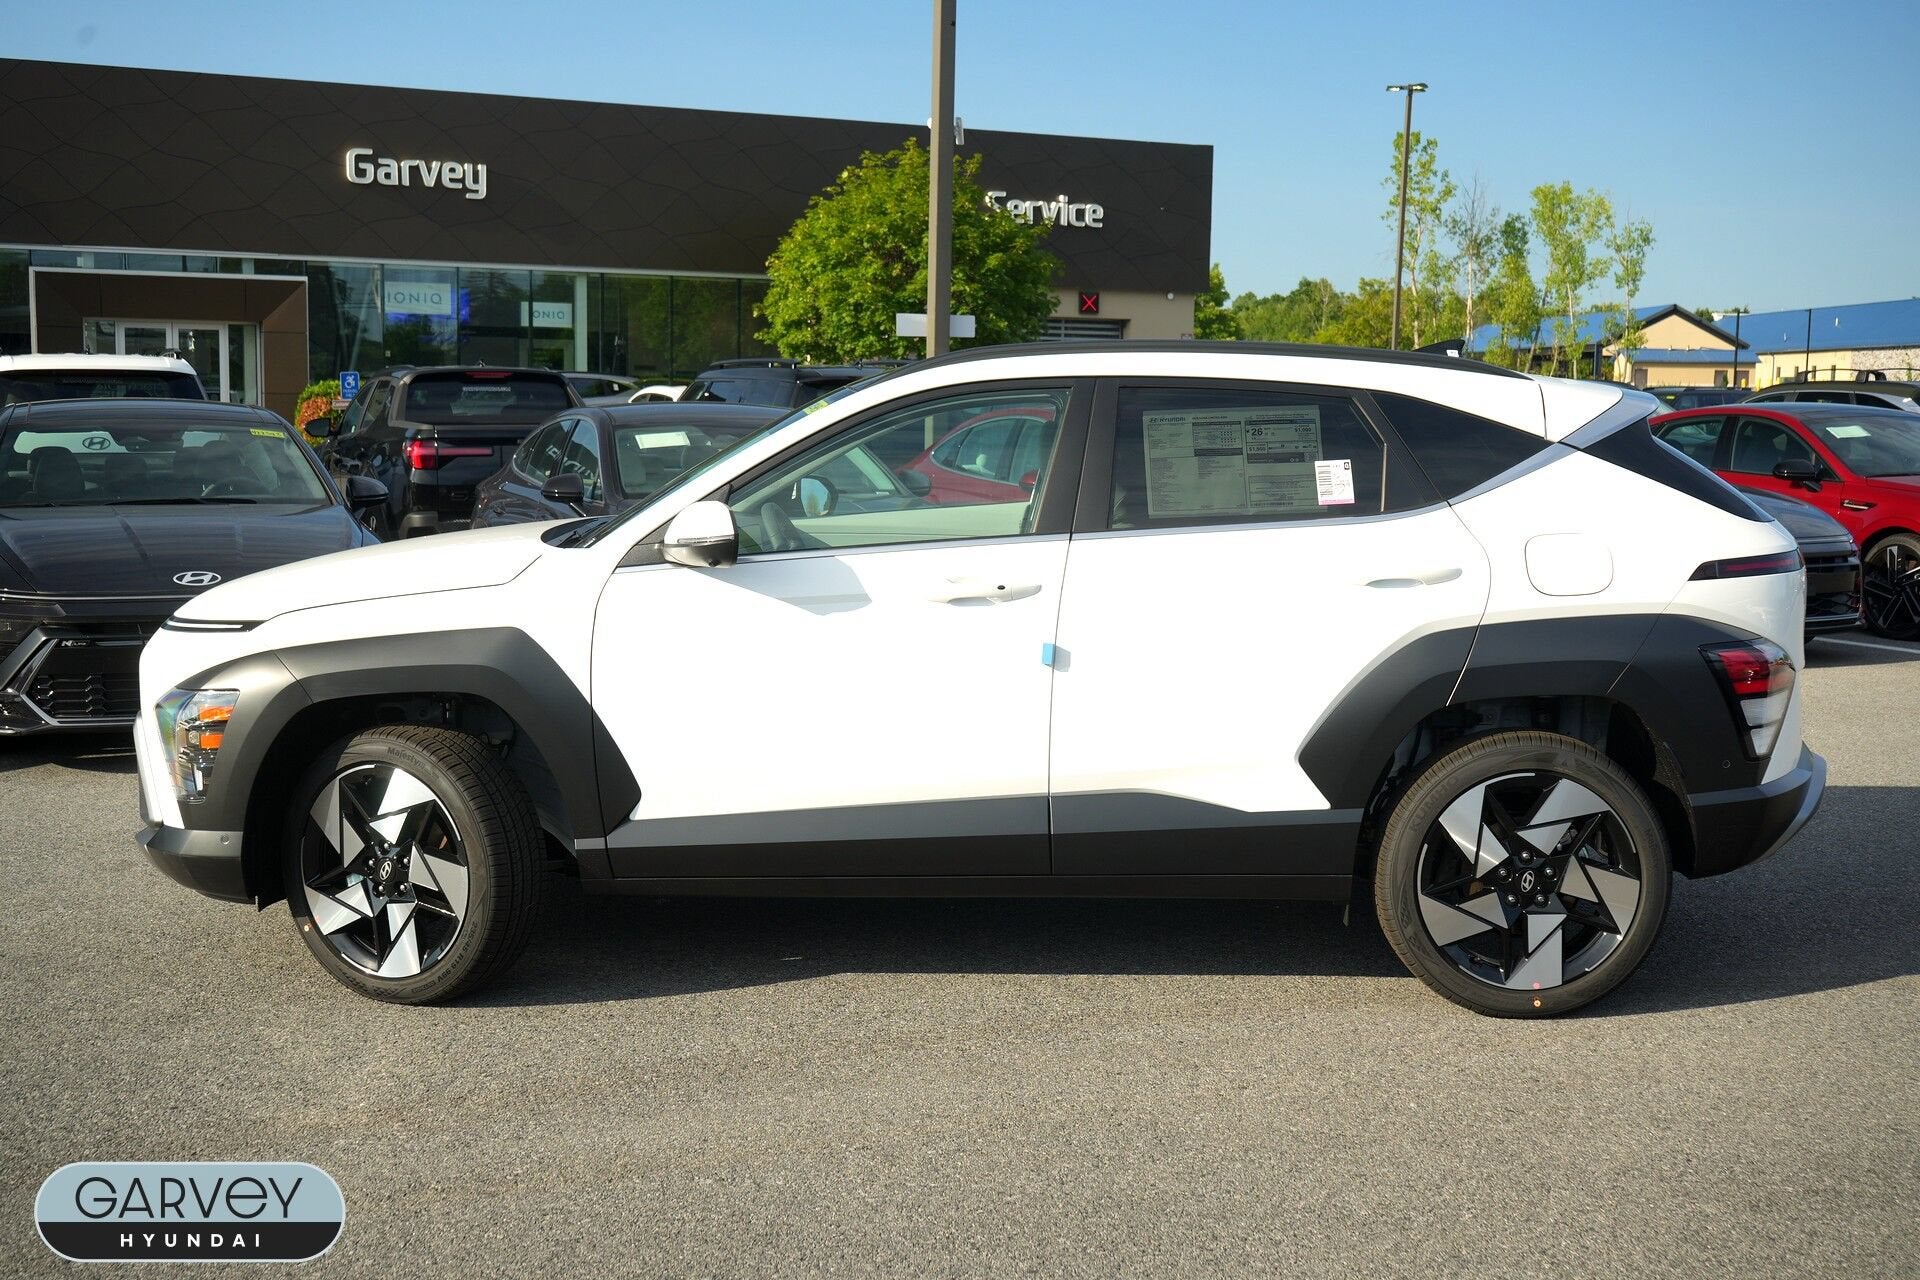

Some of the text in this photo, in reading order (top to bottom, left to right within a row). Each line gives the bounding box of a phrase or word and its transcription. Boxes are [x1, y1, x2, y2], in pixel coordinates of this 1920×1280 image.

[345, 147, 487, 200] Garvey
[387, 292, 443, 305] IONIQ
[532, 309, 565, 320] ONIQ
[1251, 427, 1263, 436] 26
